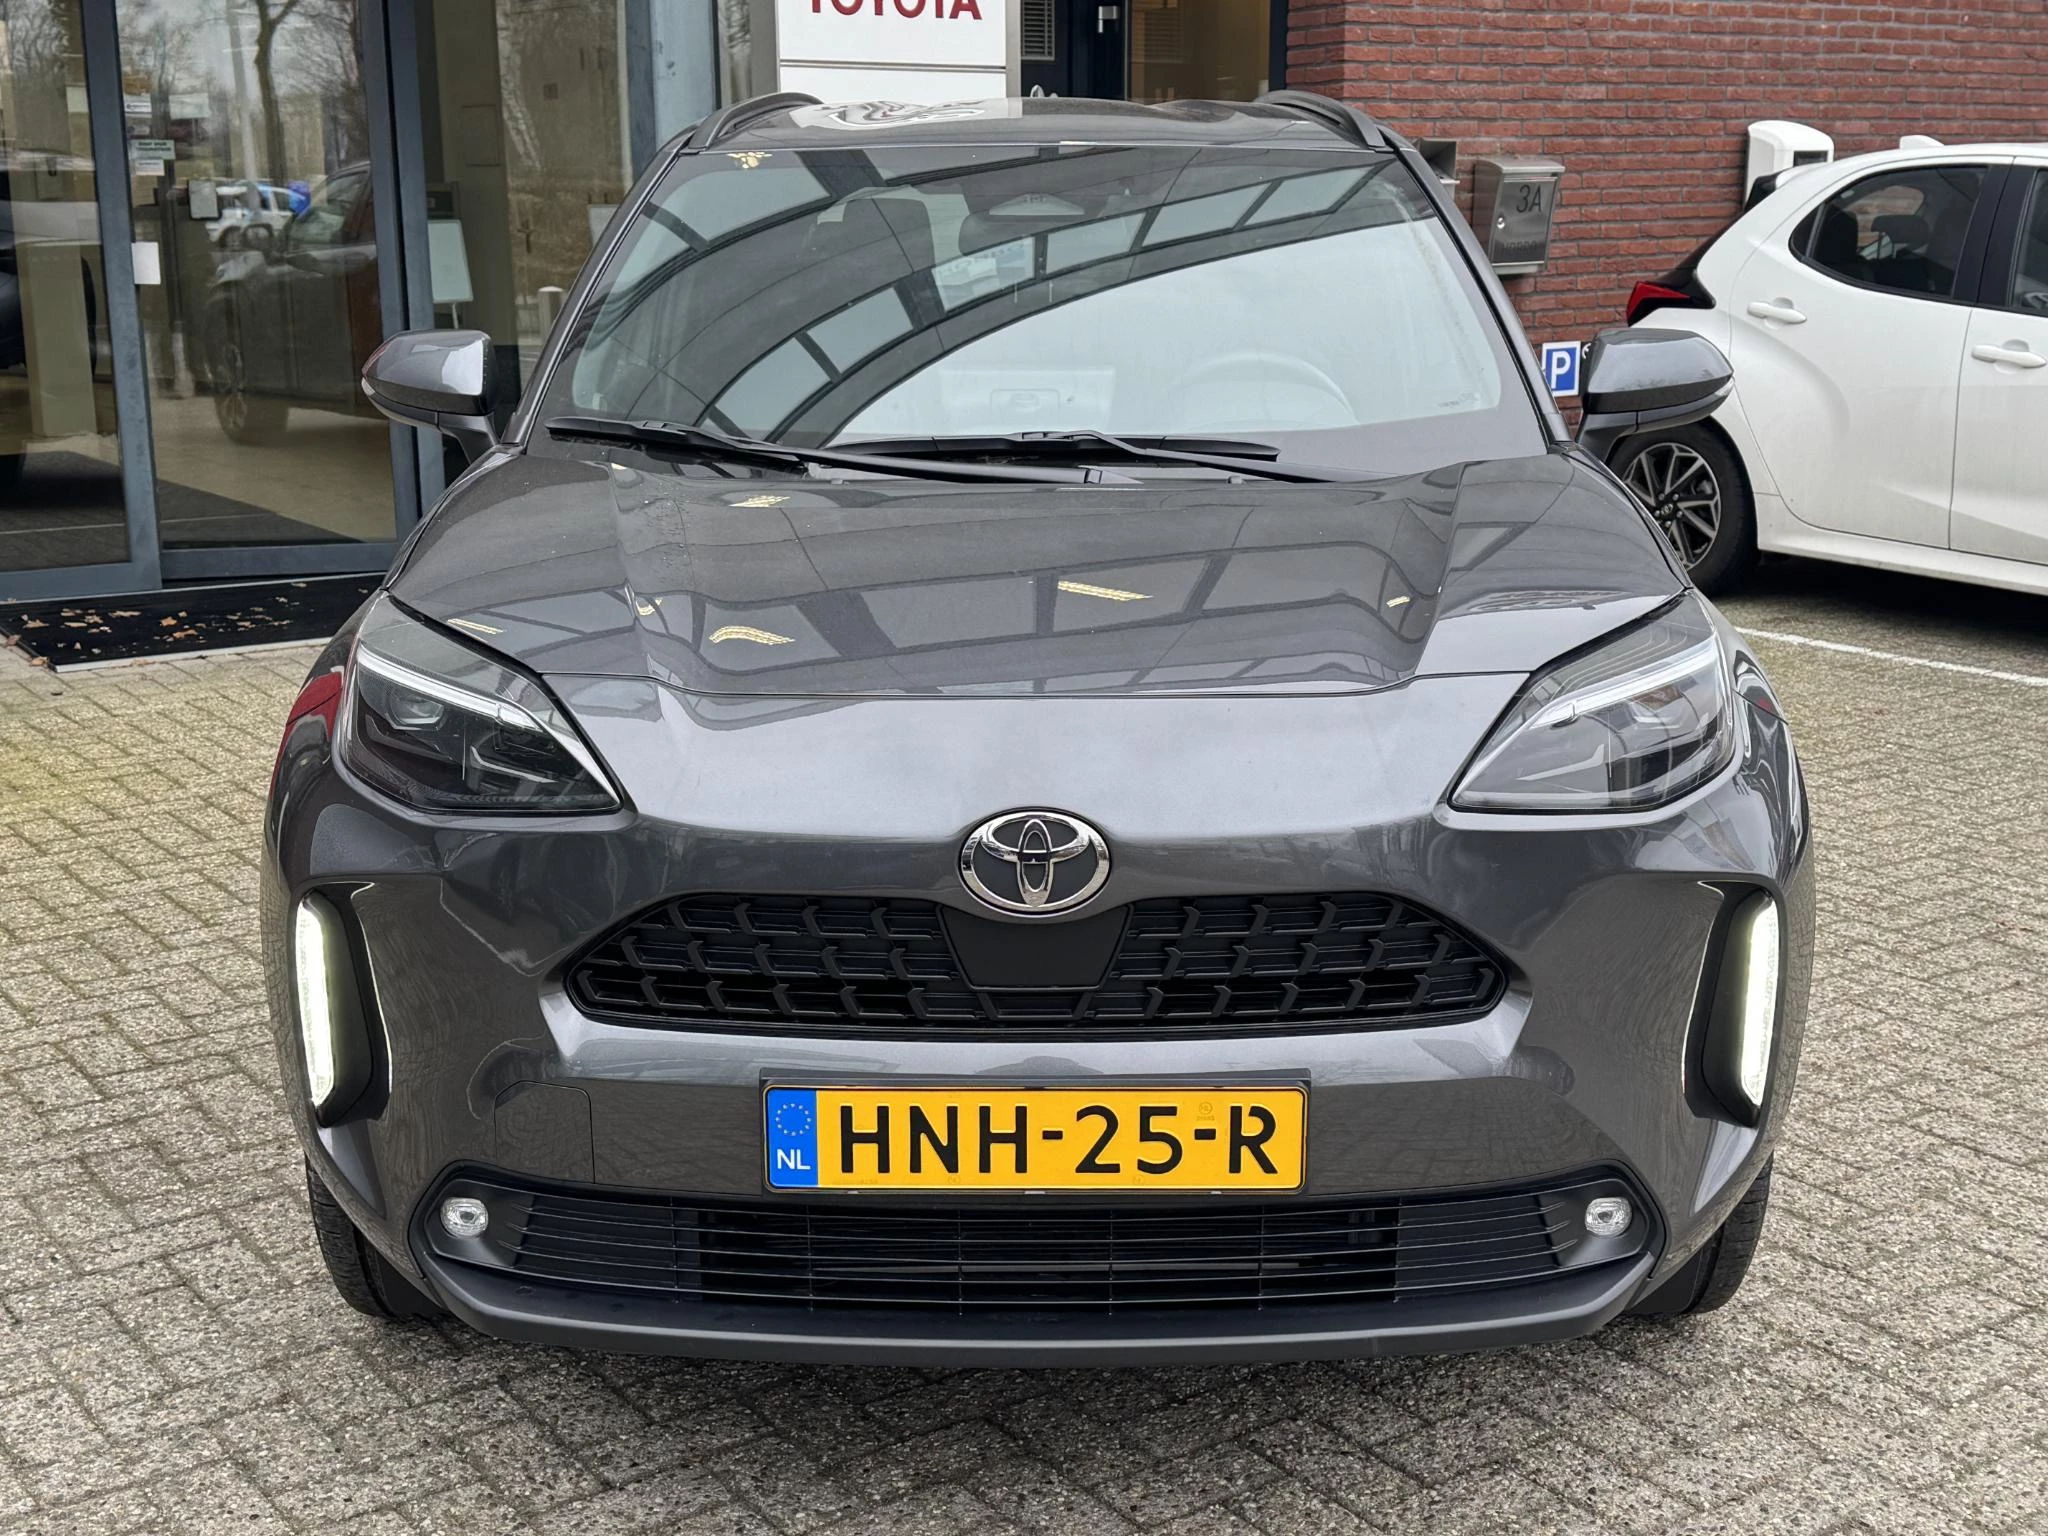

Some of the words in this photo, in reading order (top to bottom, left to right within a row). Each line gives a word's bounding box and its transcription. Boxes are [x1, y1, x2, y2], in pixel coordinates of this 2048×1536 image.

[1516, 184, 1542, 213] 3A
[1551, 350, 1571, 389] P
[840, 1104, 1279, 1175] HNH-25-R
[776, 1148, 811, 1170] NL
